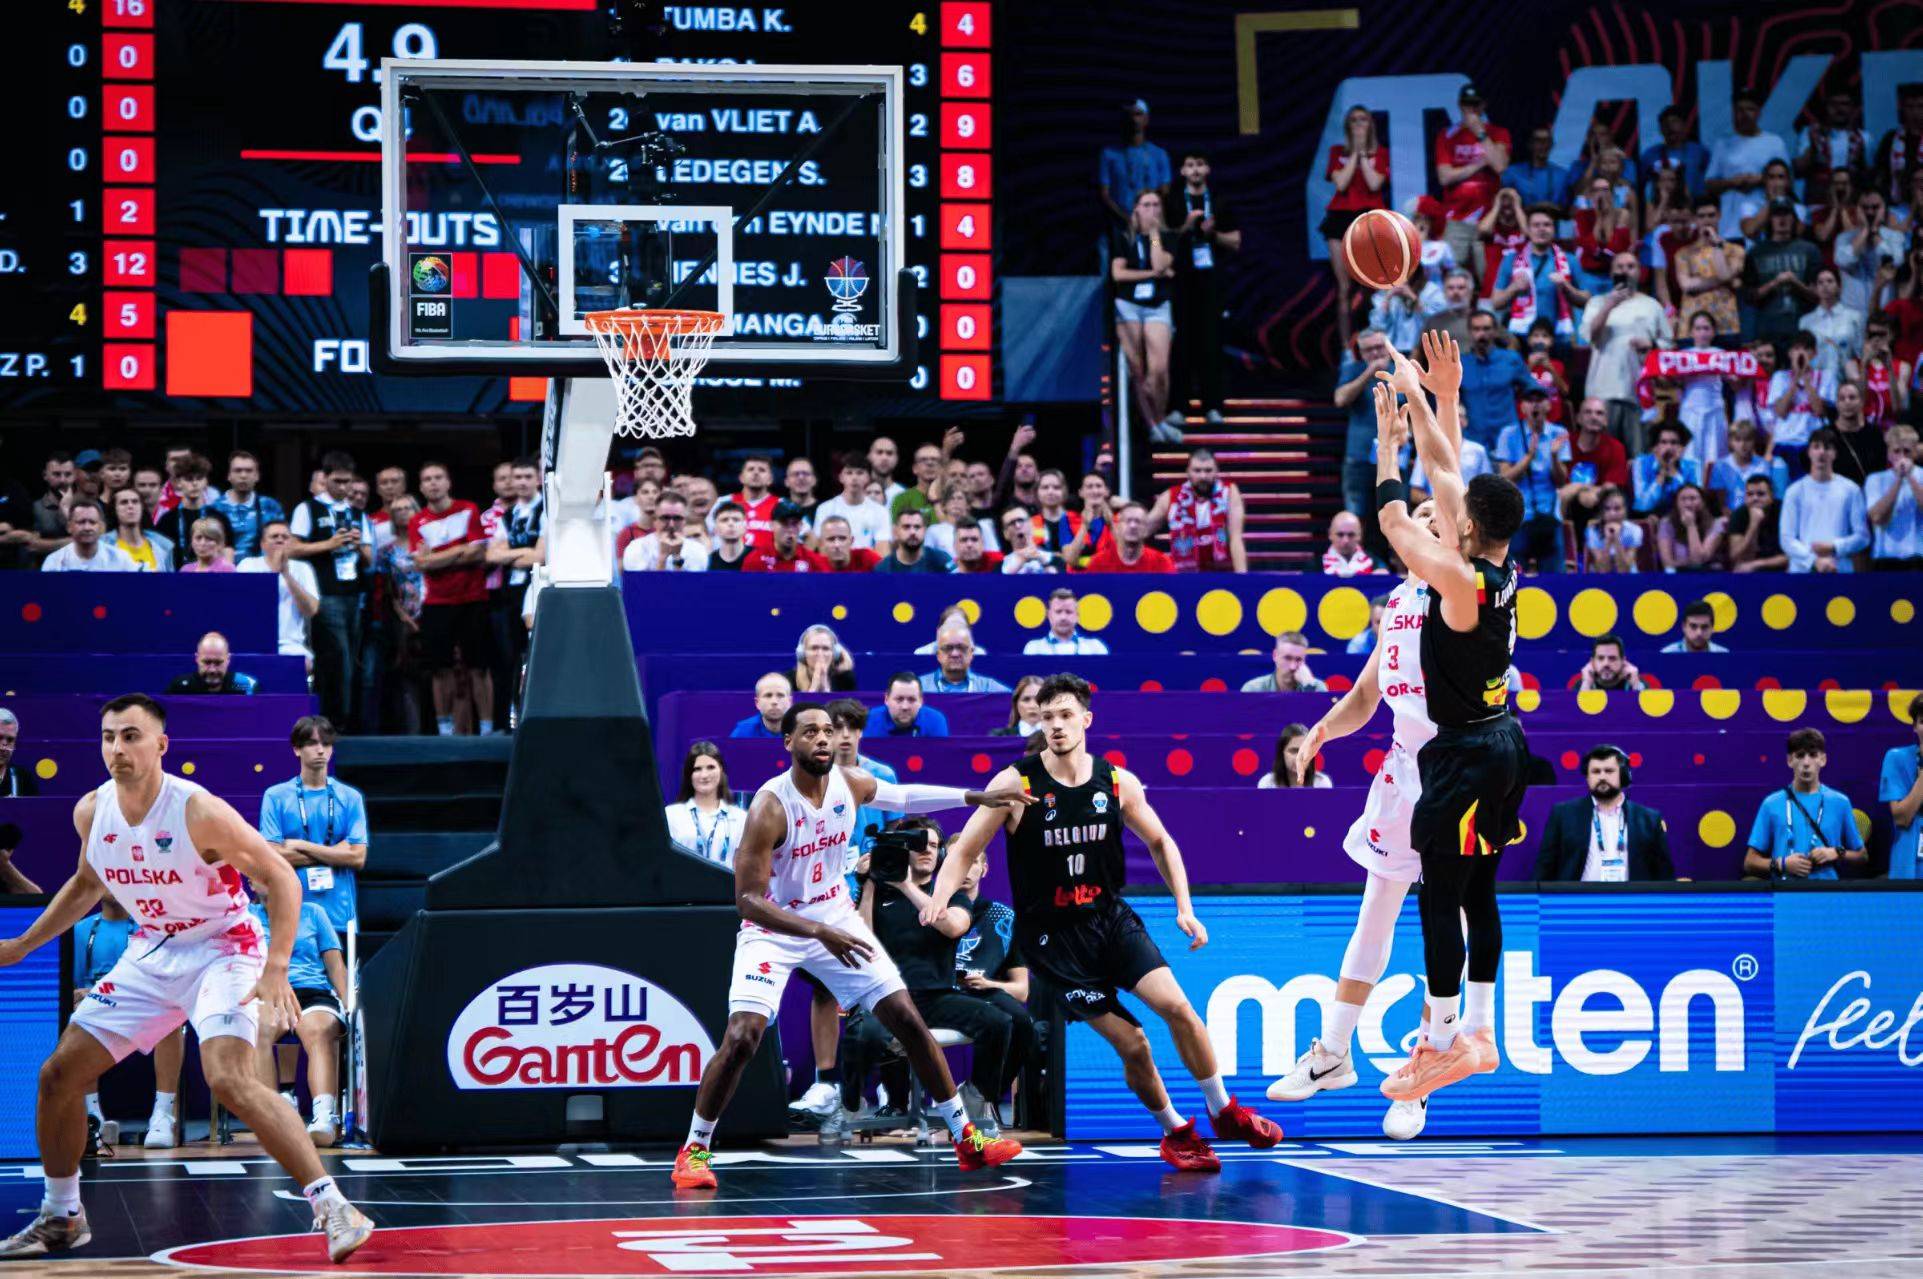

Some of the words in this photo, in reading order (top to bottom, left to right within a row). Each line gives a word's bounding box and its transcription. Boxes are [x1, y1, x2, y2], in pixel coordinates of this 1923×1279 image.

[763, 8, 793, 32] K.
[909, 12, 928, 35] 4
[957, 13, 975, 36] 4
[68, 44, 87, 67] 0
[119, 45, 137, 68] 0
[909, 63, 928, 87] 3
[957, 64, 975, 88] 6
[68, 96, 87, 118] 0
[119, 97, 138, 120] 0
[655, 112, 706, 132] van
[711, 109, 792, 133] VLIET
[909, 113, 928, 137] 2
[957, 114, 975, 138] 9
[68, 148, 87, 171] 0
[119, 149, 138, 172] 0
[799, 161, 826, 185] S.
[909, 164, 928, 188] 3
[957, 165, 975, 189] 8
[69, 199, 85, 222] 1
[120, 200, 138, 223] 2
[768, 211, 864, 236] EYNDE
[911, 214, 925, 238] 1
[957, 215, 976, 239] 4
[68, 252, 88, 275] 3
[113, 252, 146, 275] 12
[782, 262, 809, 287] J.
[956, 265, 976, 290] 0
[69, 303, 87, 325] 4
[120, 304, 138, 327] 5
[416, 302, 446, 316] FIBA
[956, 315, 976, 340] 0
[26, 354, 50, 377] P.
[69, 355, 85, 378] 1
[120, 355, 138, 379] 0
[1659, 350, 1758, 377] POLAND
[956, 366, 976, 390] 0
[104, 867, 183, 885] POLSKA
[1066, 853, 1085, 877] 10
[496, 983, 648, 1026] 百岁山
[1206, 950, 1745, 1076] moten
